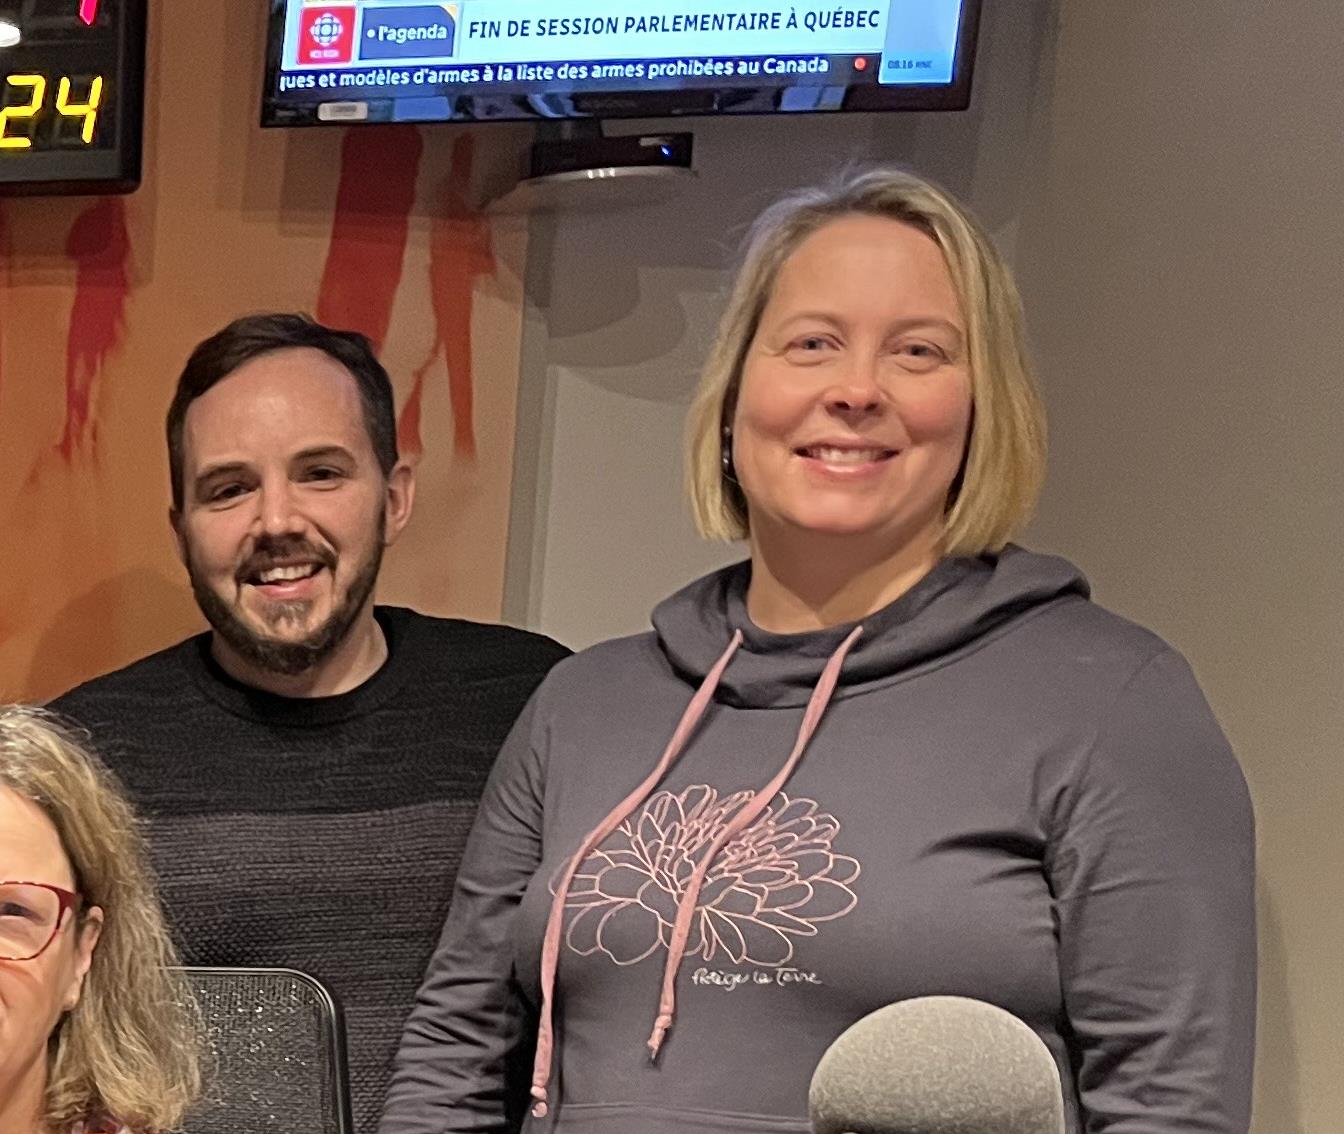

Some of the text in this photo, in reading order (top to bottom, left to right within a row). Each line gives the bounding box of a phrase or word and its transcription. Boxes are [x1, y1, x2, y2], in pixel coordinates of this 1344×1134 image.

[378, 24, 448, 44] l'agenda
[469, 6, 881, 39] FIN DE SESSION PARLEMENTAIRE À QUÉBEC
[318, 72, 337, 88] et
[340, 69, 410, 87] modèles
[413, 68, 480, 85] d'armes
[484, 66, 494, 82] à
[497, 65, 513, 82] la
[516, 64, 554, 81] liste
[557, 63, 589, 80] des
[591, 63, 645, 79] armes
[647, 59, 734, 80] prohibées
[737, 60, 760, 76] au
[763, 57, 830, 75] Canada
